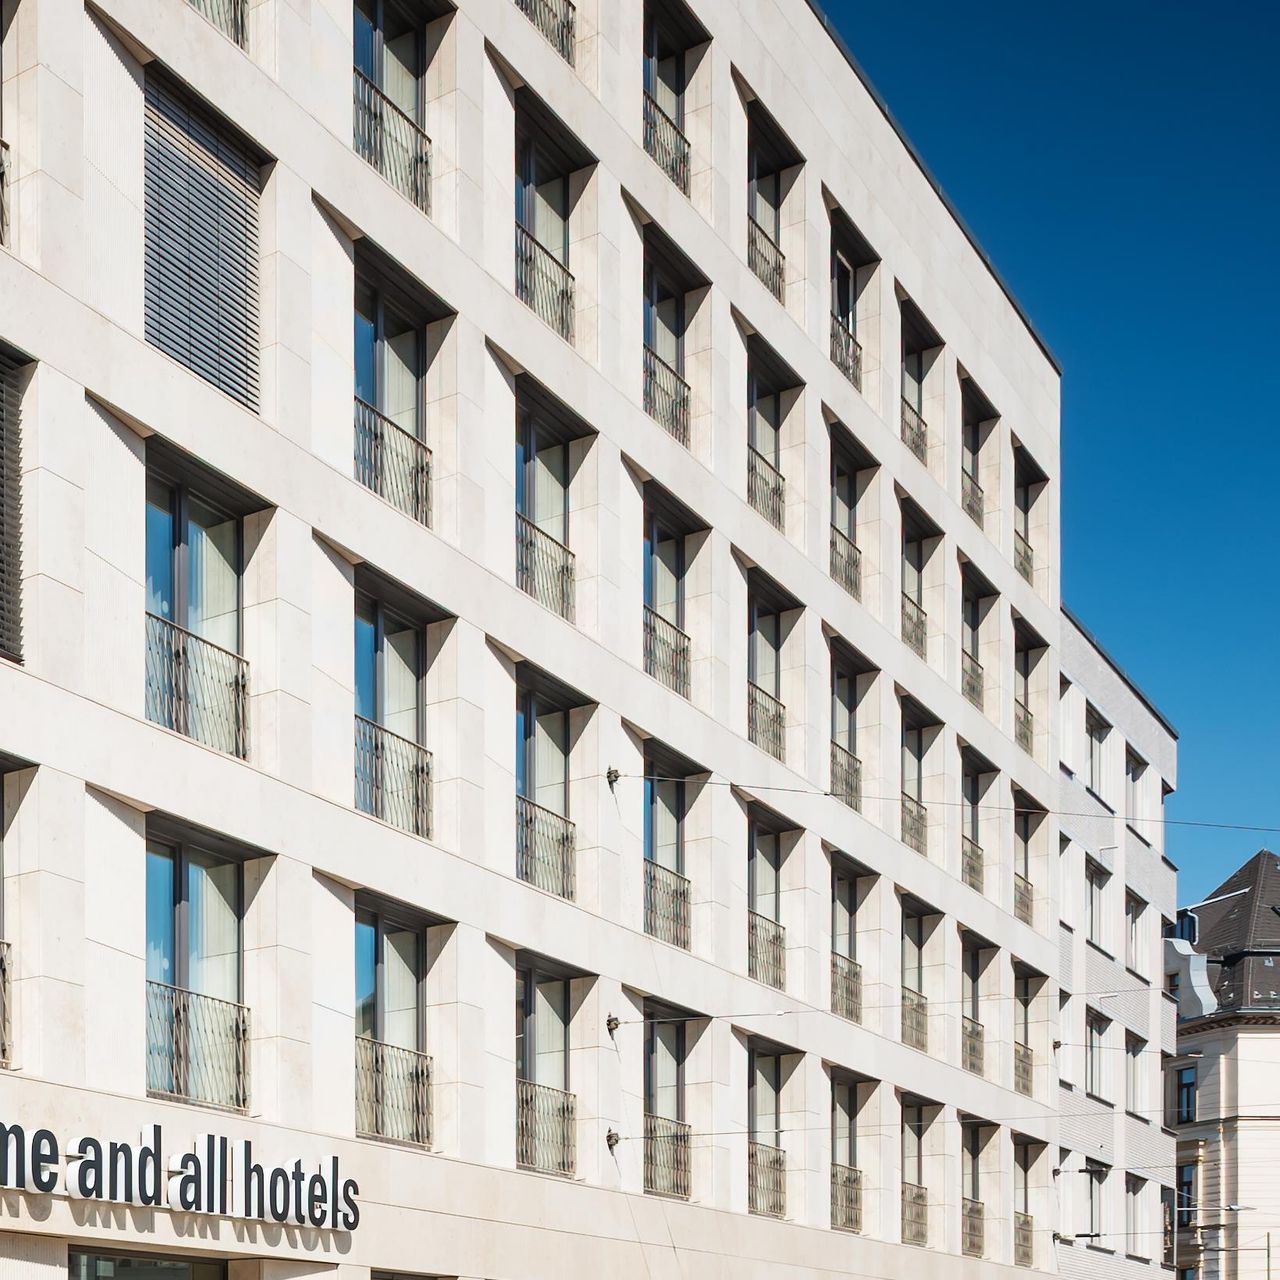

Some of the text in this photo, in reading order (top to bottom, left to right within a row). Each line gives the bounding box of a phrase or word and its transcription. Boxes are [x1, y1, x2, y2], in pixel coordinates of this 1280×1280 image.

[77, 1124, 162, 1207] and
[180, 1133, 228, 1215] all
[244, 1139, 360, 1232] hotels
